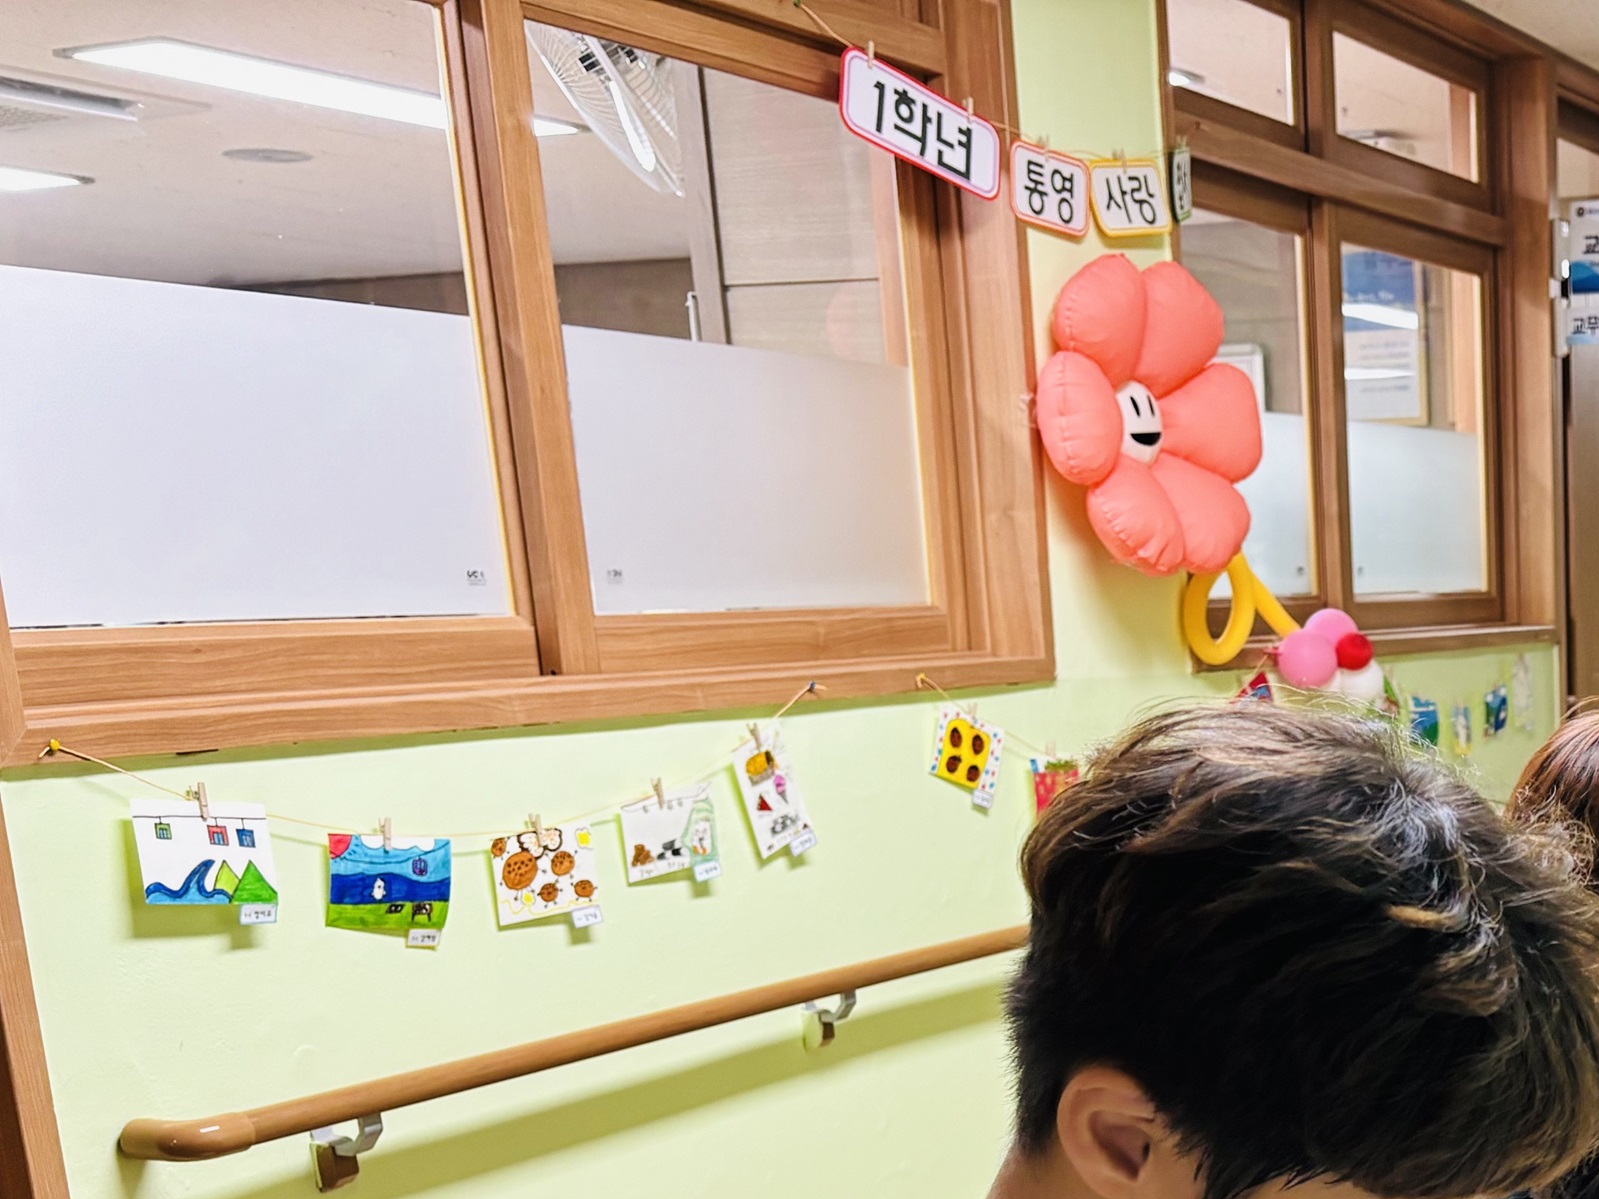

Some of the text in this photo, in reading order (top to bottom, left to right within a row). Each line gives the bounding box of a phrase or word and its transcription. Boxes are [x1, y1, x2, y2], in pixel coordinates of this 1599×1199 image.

[873, 79, 972, 182] 1학년
[1024, 159, 1075, 225] 통영
[1105, 175, 1157, 226] 사랑
